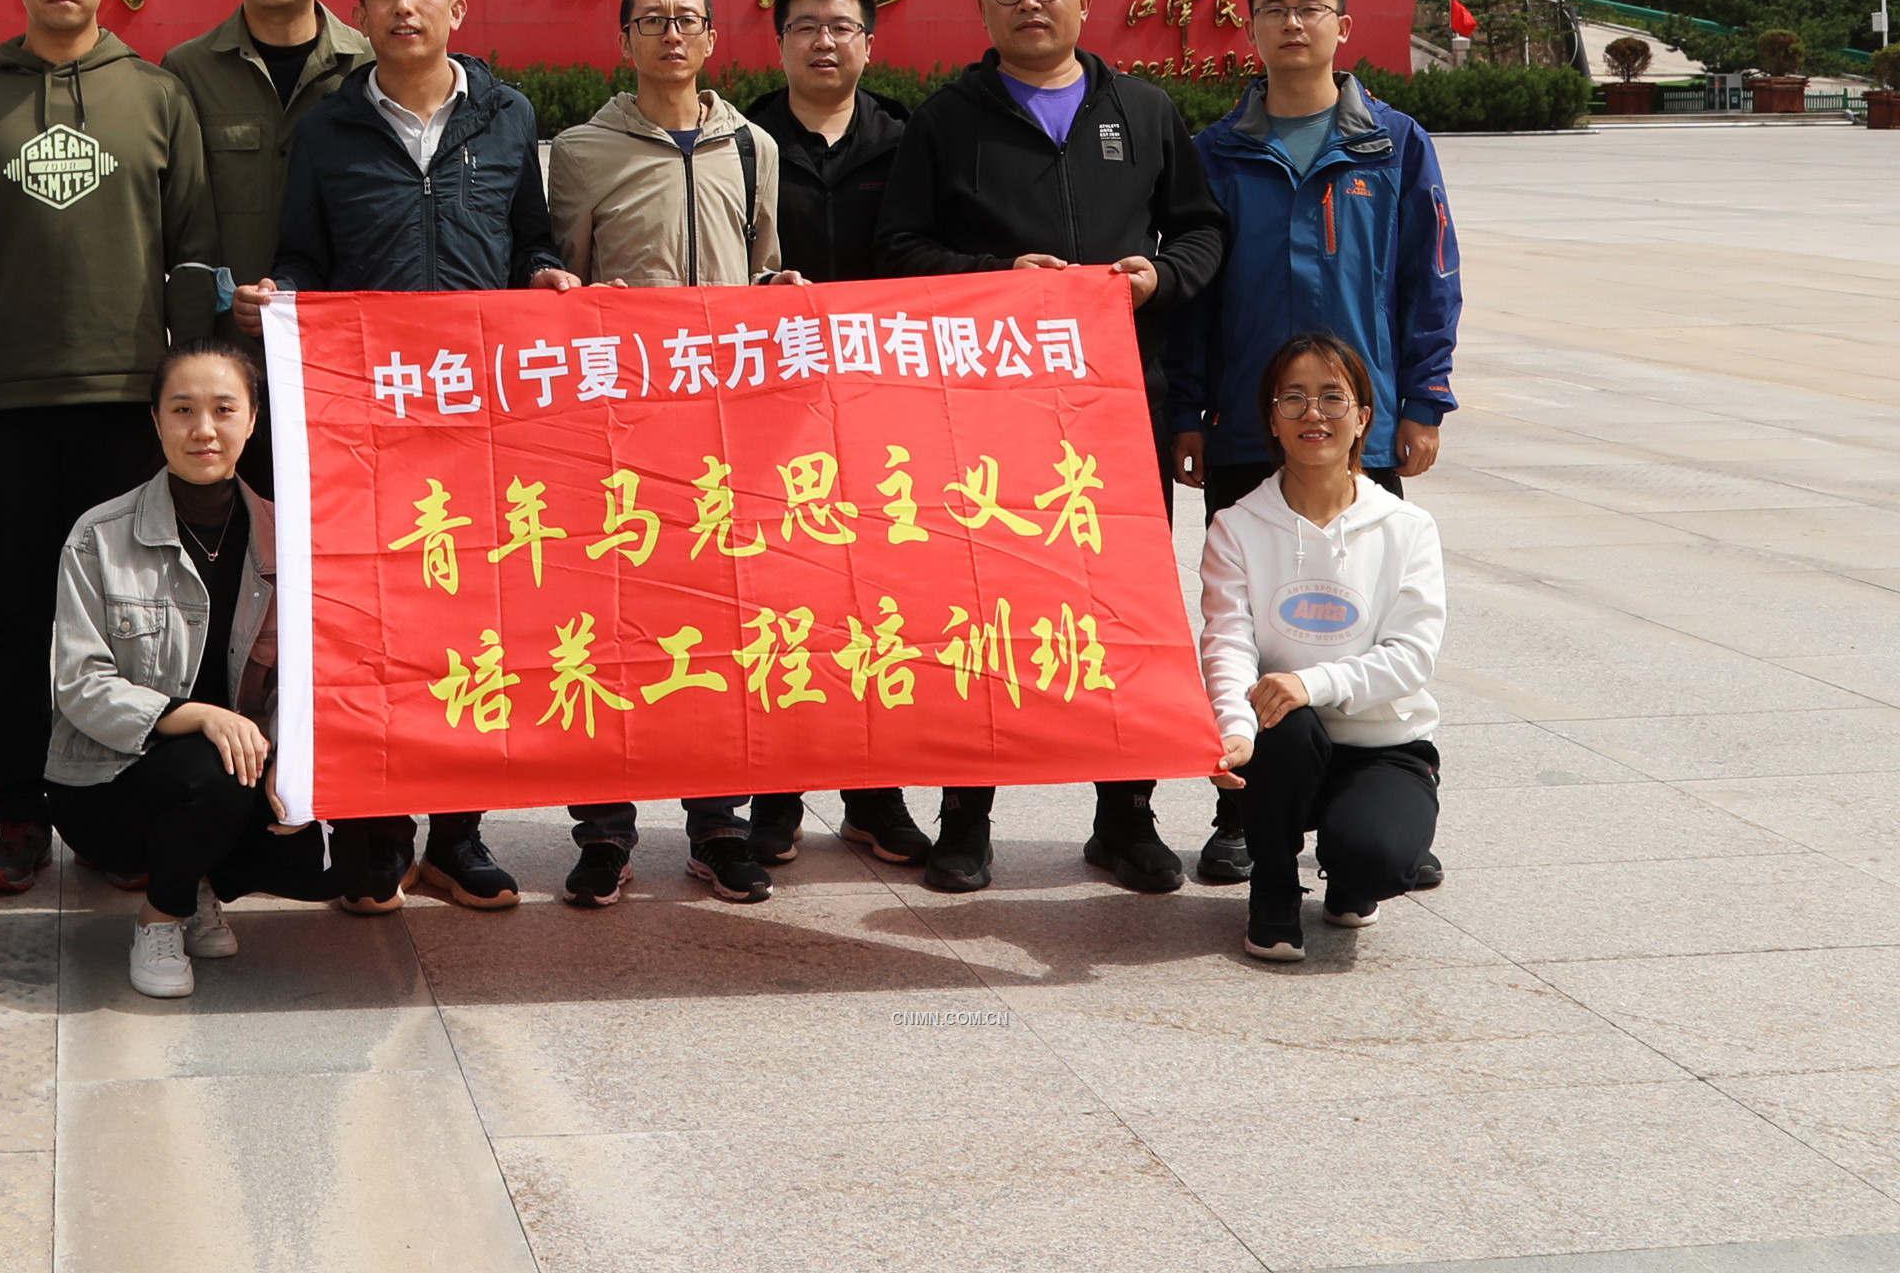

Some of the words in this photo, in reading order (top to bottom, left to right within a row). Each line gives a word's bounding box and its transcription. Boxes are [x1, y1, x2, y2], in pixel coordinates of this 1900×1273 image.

[26, 133, 94, 161] BREAK
[45, 161, 77, 171] YOUR
[27, 171, 94, 202] LIMITS
[387, 439, 1104, 596] 青年马克思主义者
[427, 595, 1116, 739] 培养工程培训班
